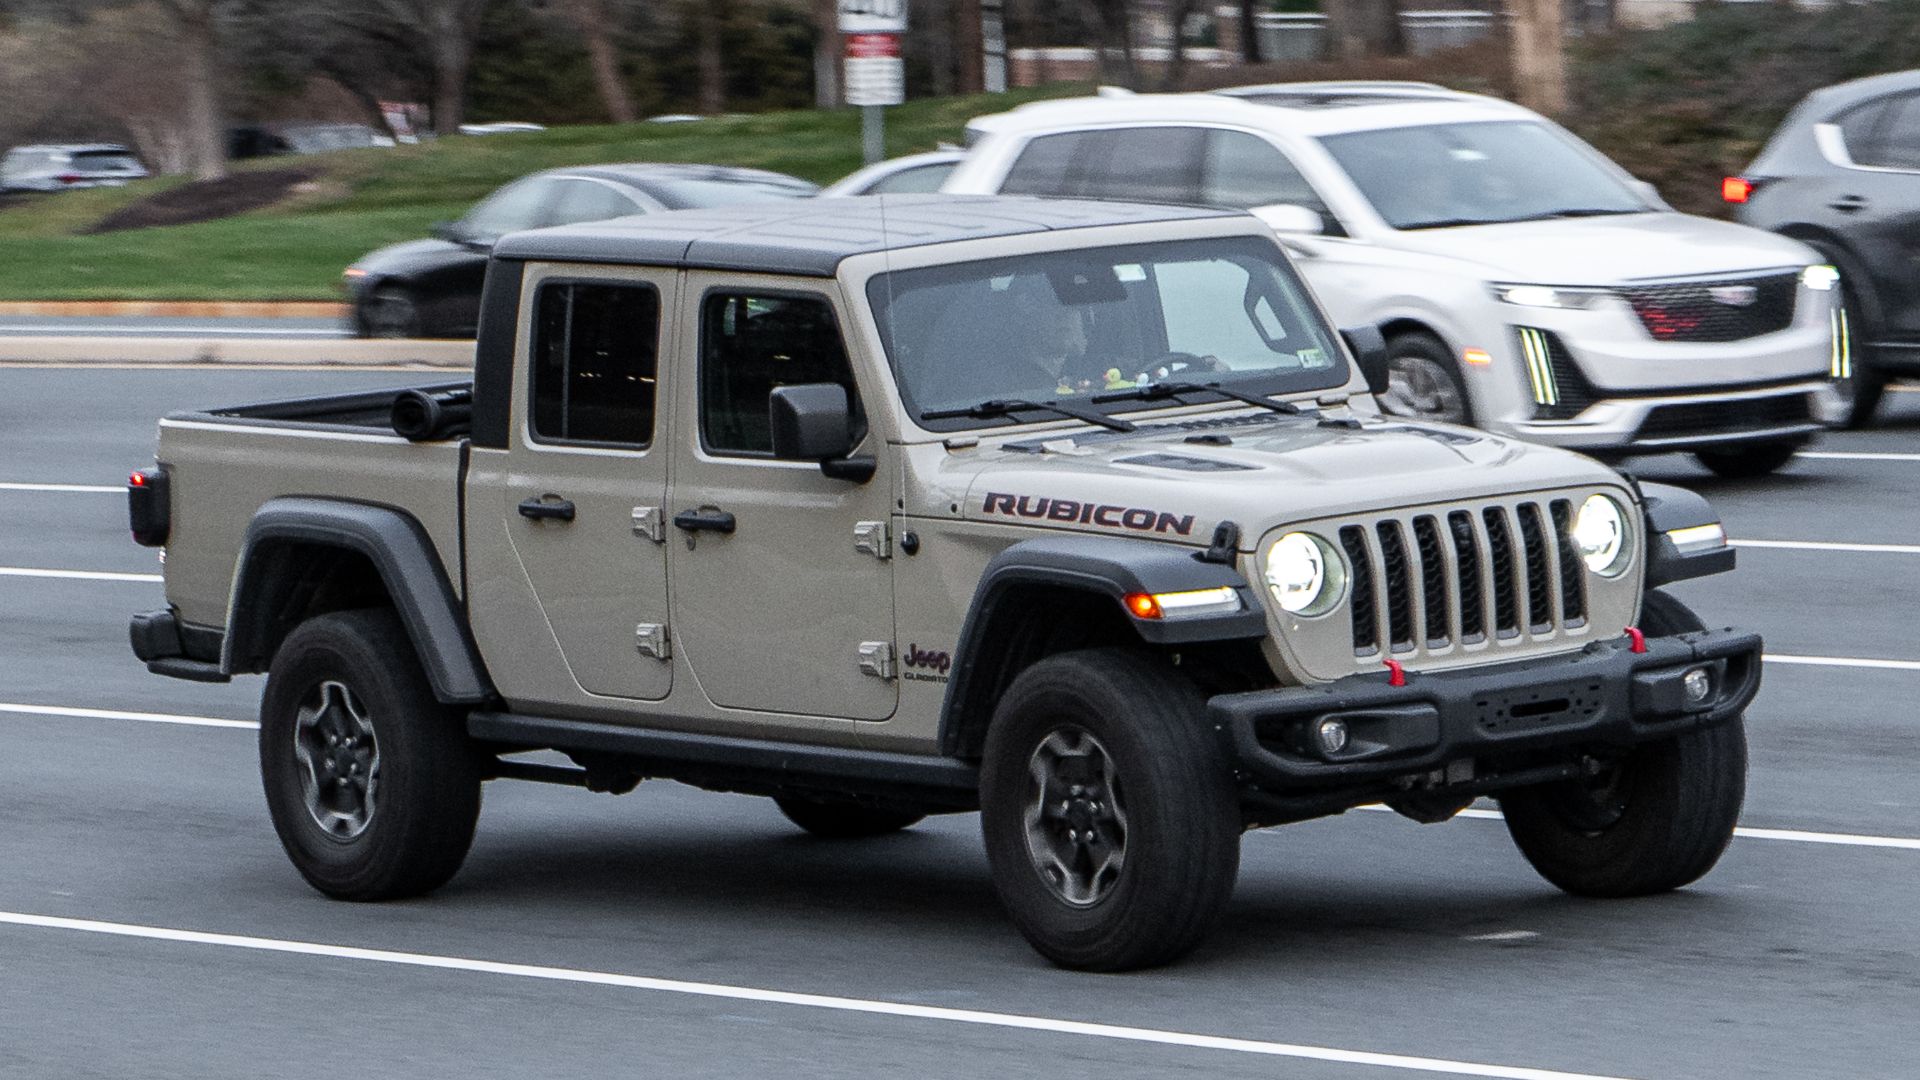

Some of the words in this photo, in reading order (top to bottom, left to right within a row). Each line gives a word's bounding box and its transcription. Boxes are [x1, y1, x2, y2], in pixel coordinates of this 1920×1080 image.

[983, 492, 1195, 536] RUBICON
[904, 643, 950, 674] Jeep
[904, 672, 949, 683] GLADIATO
